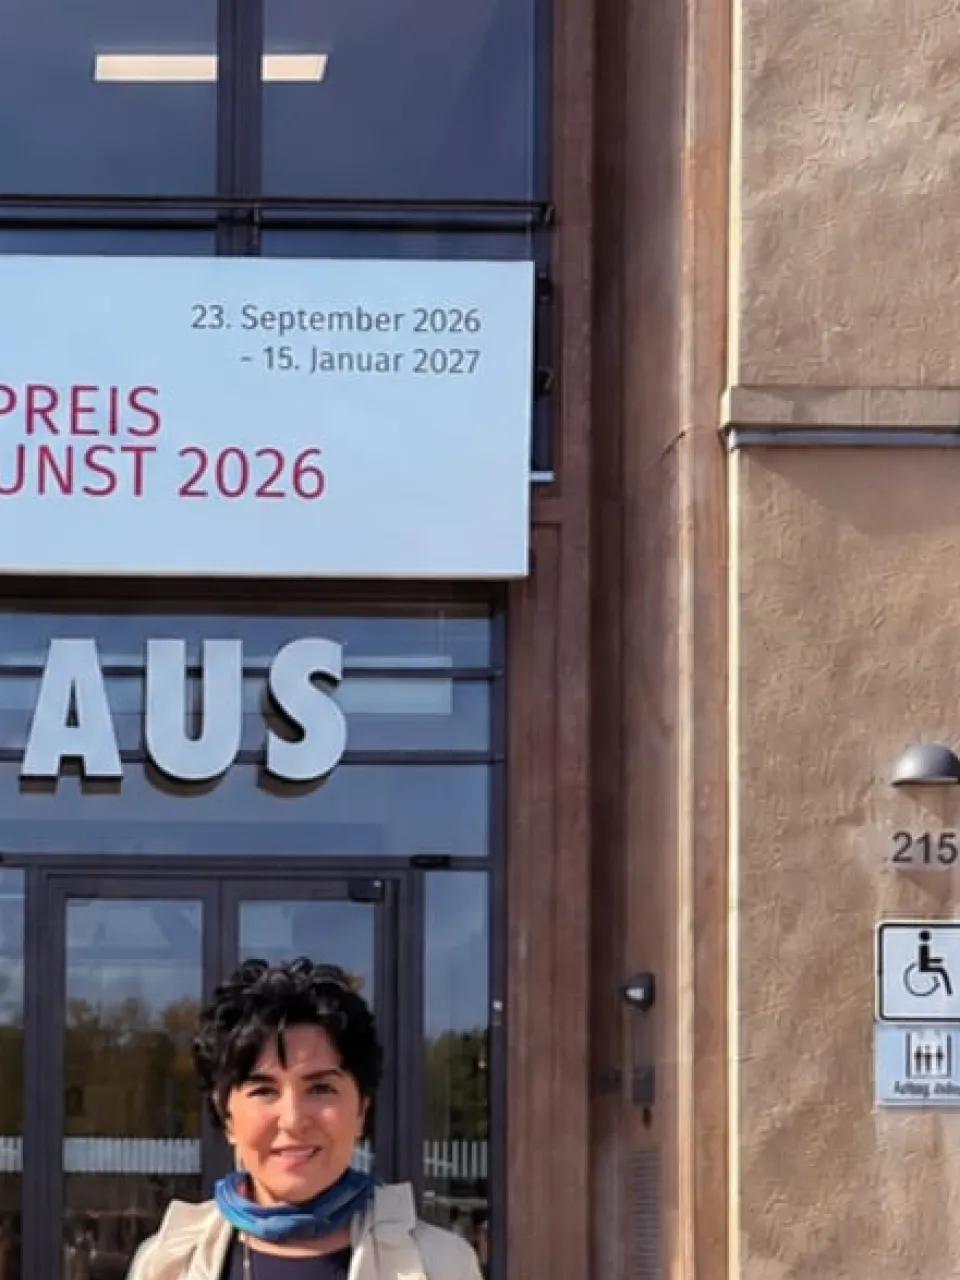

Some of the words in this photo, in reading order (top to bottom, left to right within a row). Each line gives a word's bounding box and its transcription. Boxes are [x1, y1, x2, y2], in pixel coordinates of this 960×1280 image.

[190, 304, 232, 330] 23.
[240, 303, 406, 337] September
[412, 307, 482, 333] 2026
[262, 345, 300, 371] 15.
[309, 345, 405, 374] Januar
[412, 348, 481, 374] 2027
[178, 446, 325, 500] 2026
[892, 831, 959, 865] 215
